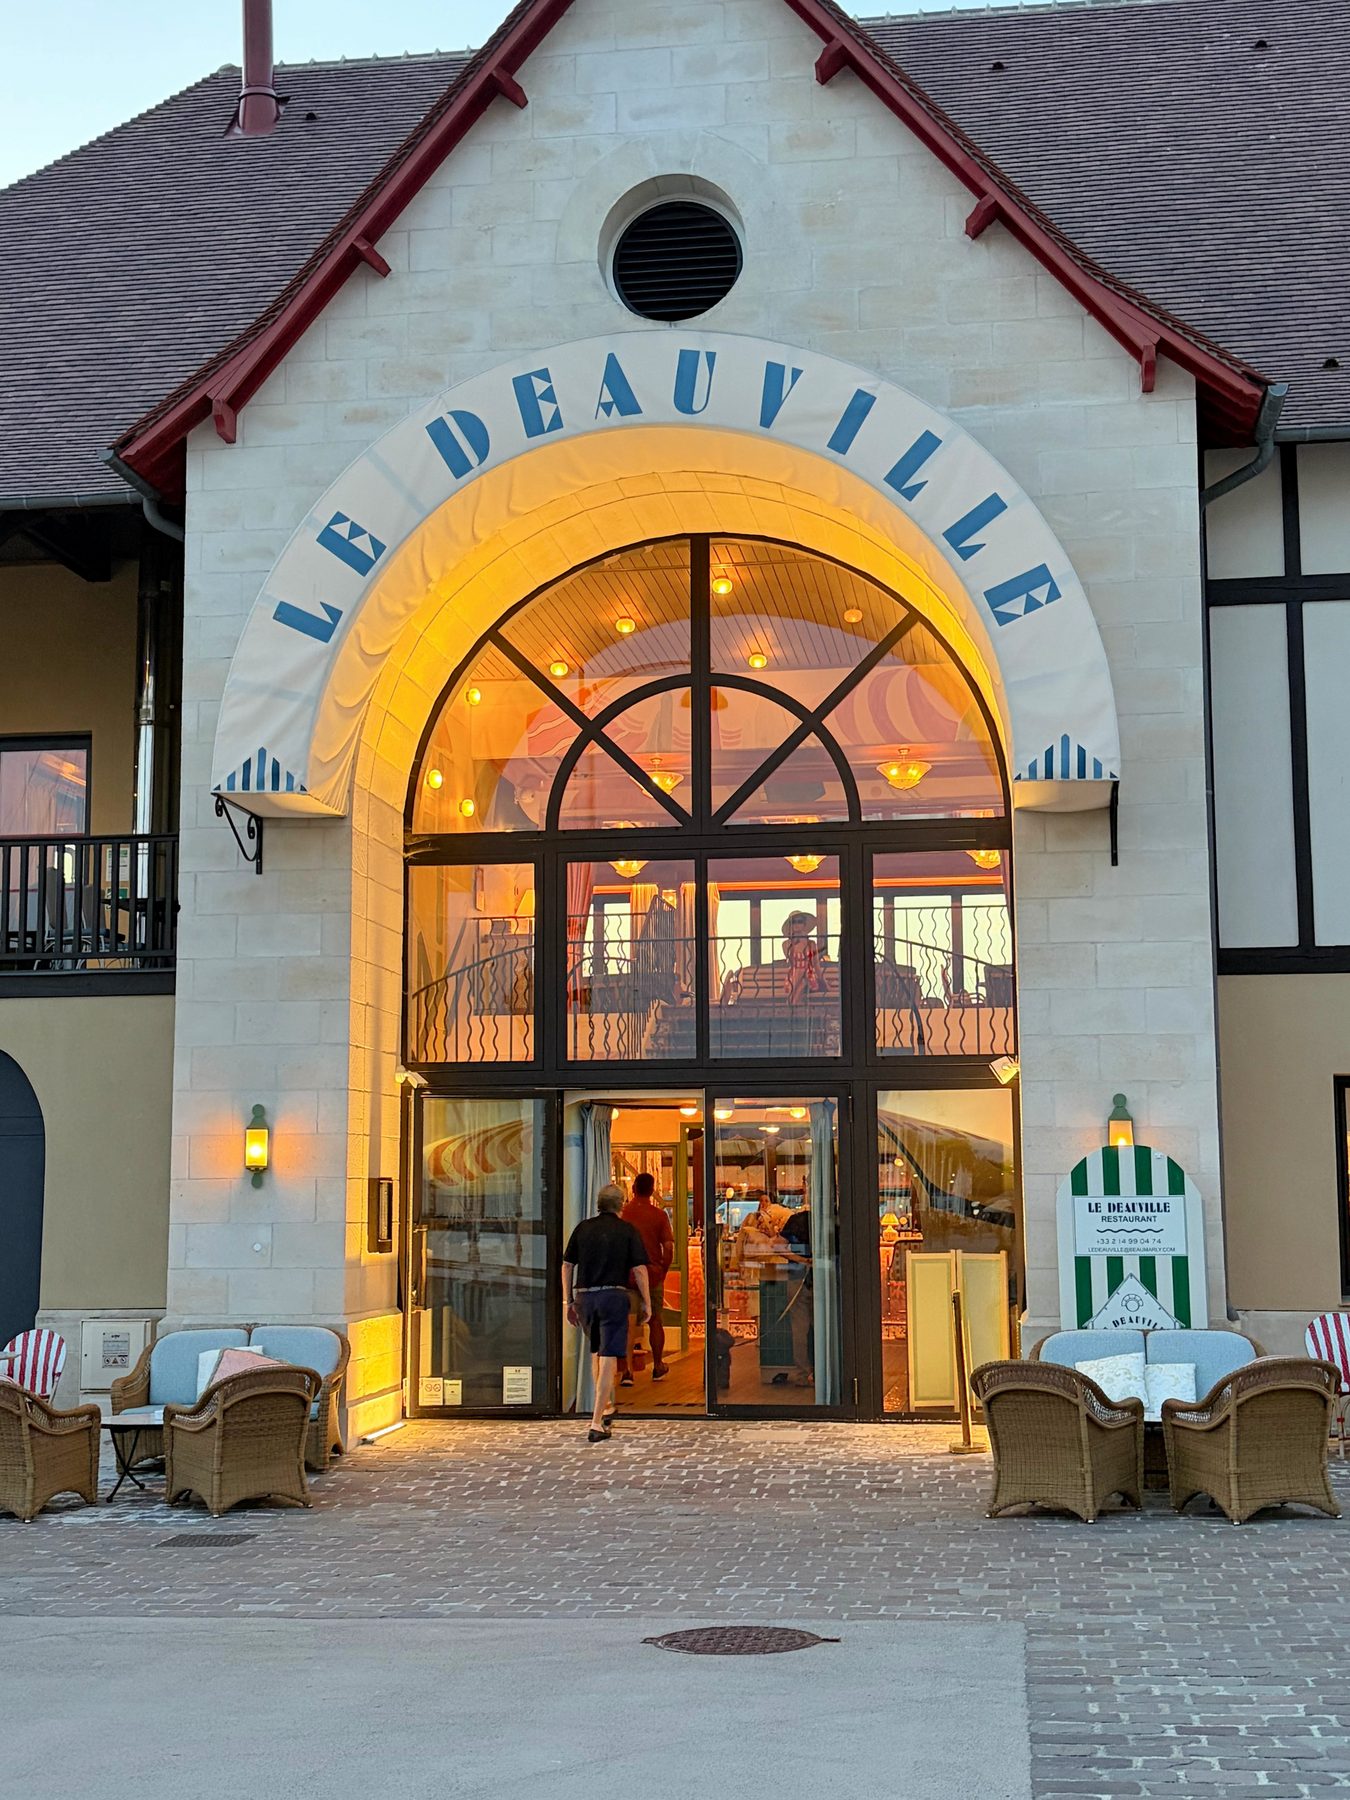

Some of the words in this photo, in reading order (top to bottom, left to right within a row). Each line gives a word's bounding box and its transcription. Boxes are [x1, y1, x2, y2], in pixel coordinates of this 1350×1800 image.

[273, 511, 387, 643] LE
[425, 349, 1062, 626] DEAUVILLE
[1088, 1202, 1101, 1213] LE
[1108, 1202, 1170, 1213] DEAUVILLE
